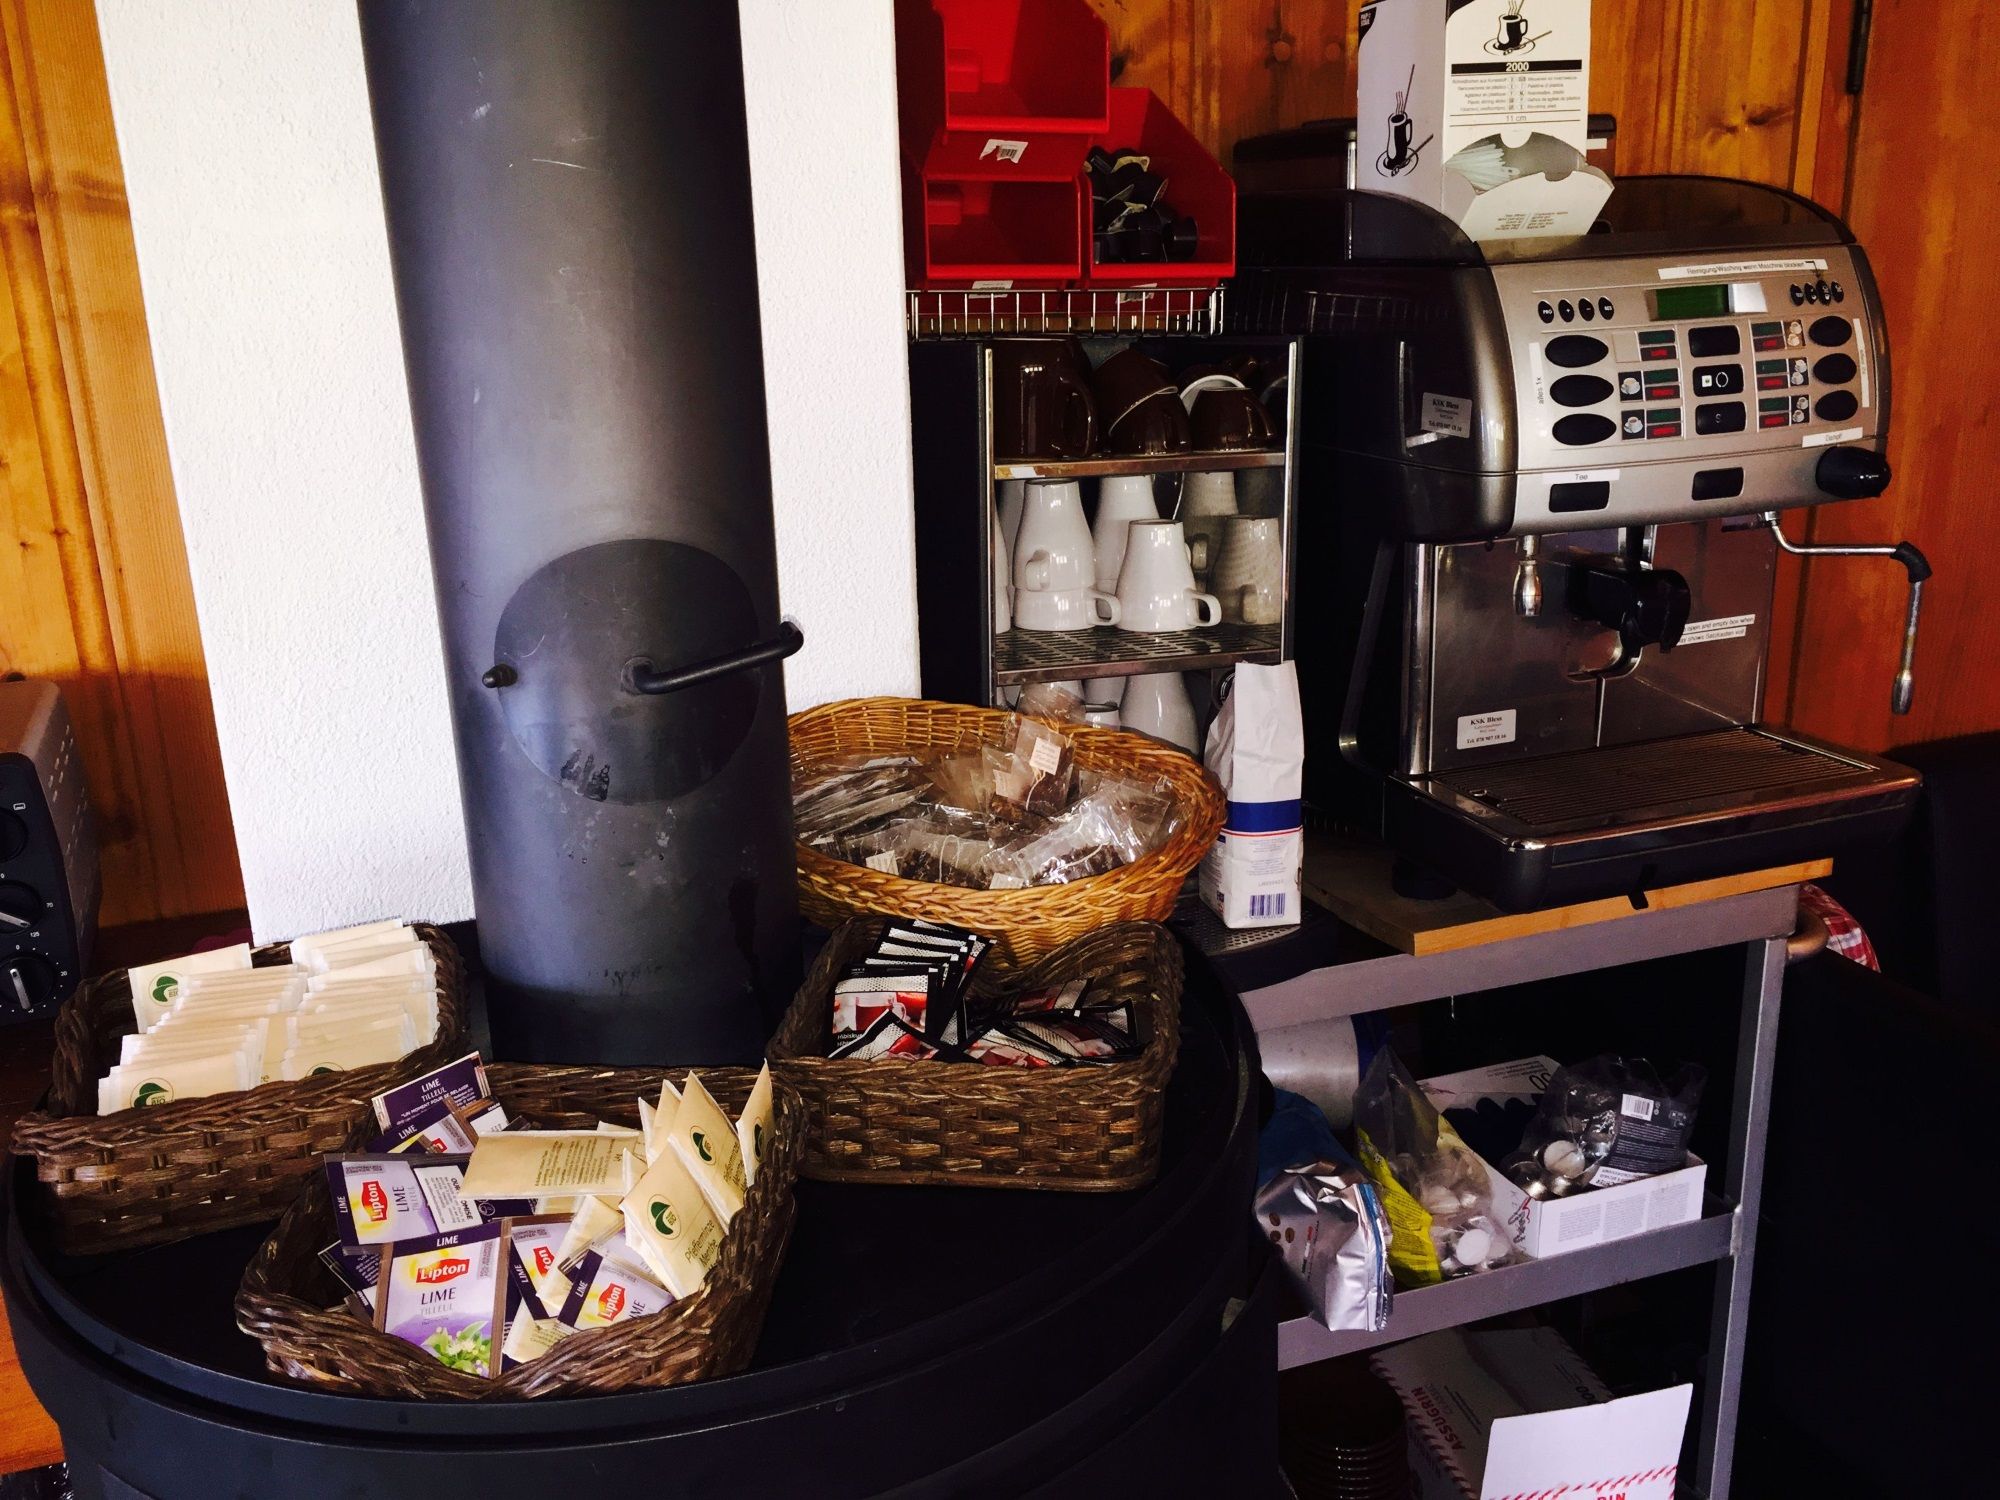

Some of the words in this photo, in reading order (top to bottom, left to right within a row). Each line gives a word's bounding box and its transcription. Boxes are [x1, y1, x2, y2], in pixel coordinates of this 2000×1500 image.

[1506, 62, 1530, 72] 2000
[421, 1078, 440, 1093] LIME
[421, 1086, 447, 1102] TILLEUL
[398, 1124, 418, 1140] LIME
[336, 1196, 348, 1214] LIME
[368, 1183, 384, 1220] Lipton
[392, 1186, 410, 1212] LIME
[436, 1234, 459, 1248] LIME
[685, 1220, 715, 1262] Pfefferminze
[420, 1262, 466, 1281] Lipton
[514, 1264, 529, 1284] LIME
[421, 1287, 457, 1305] LIME
[575, 1280, 588, 1298] LIME
[602, 1286, 622, 1318] Lipton
[628, 1299, 646, 1320] IME
[1411, 1386, 1466, 1450] ASSUGRIN
